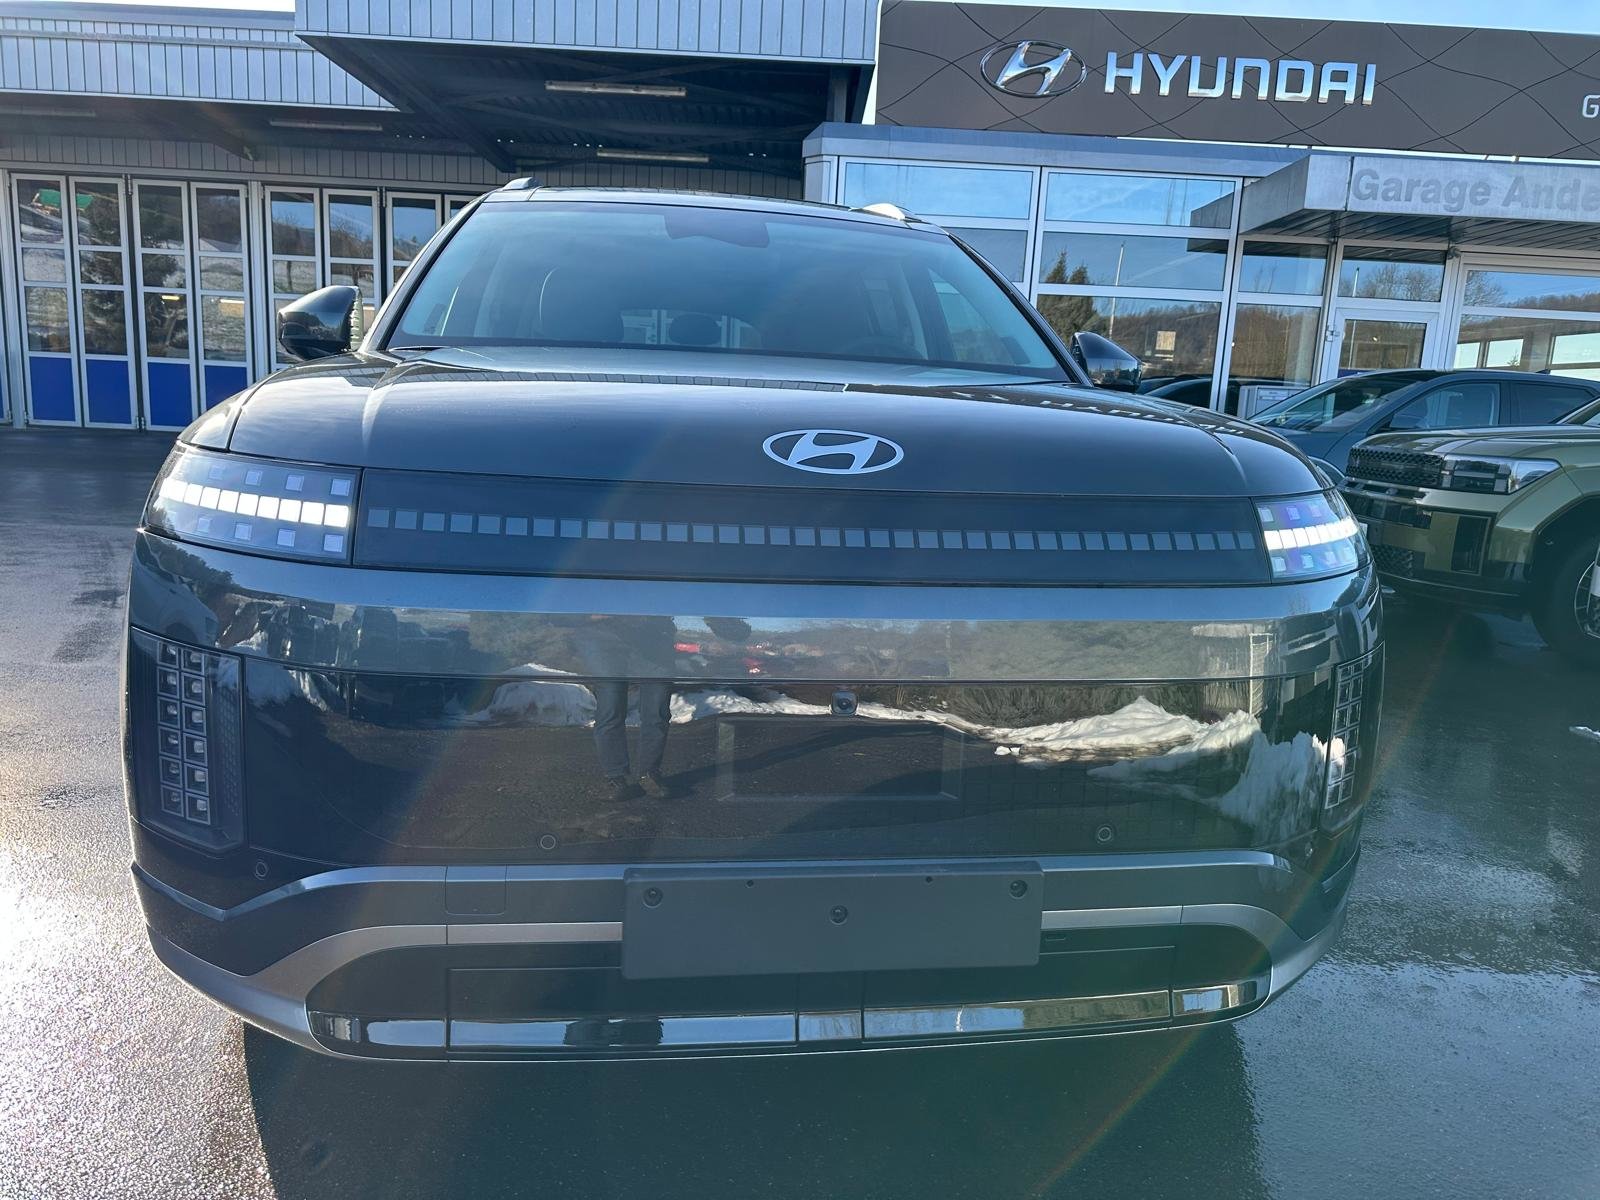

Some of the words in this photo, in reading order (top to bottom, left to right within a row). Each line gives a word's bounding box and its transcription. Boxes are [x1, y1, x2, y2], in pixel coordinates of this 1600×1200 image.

[1104, 51, 1377, 106] HYUNDAI
[1582, 94, 1600, 118] G
[1351, 168, 1492, 213] Garage
